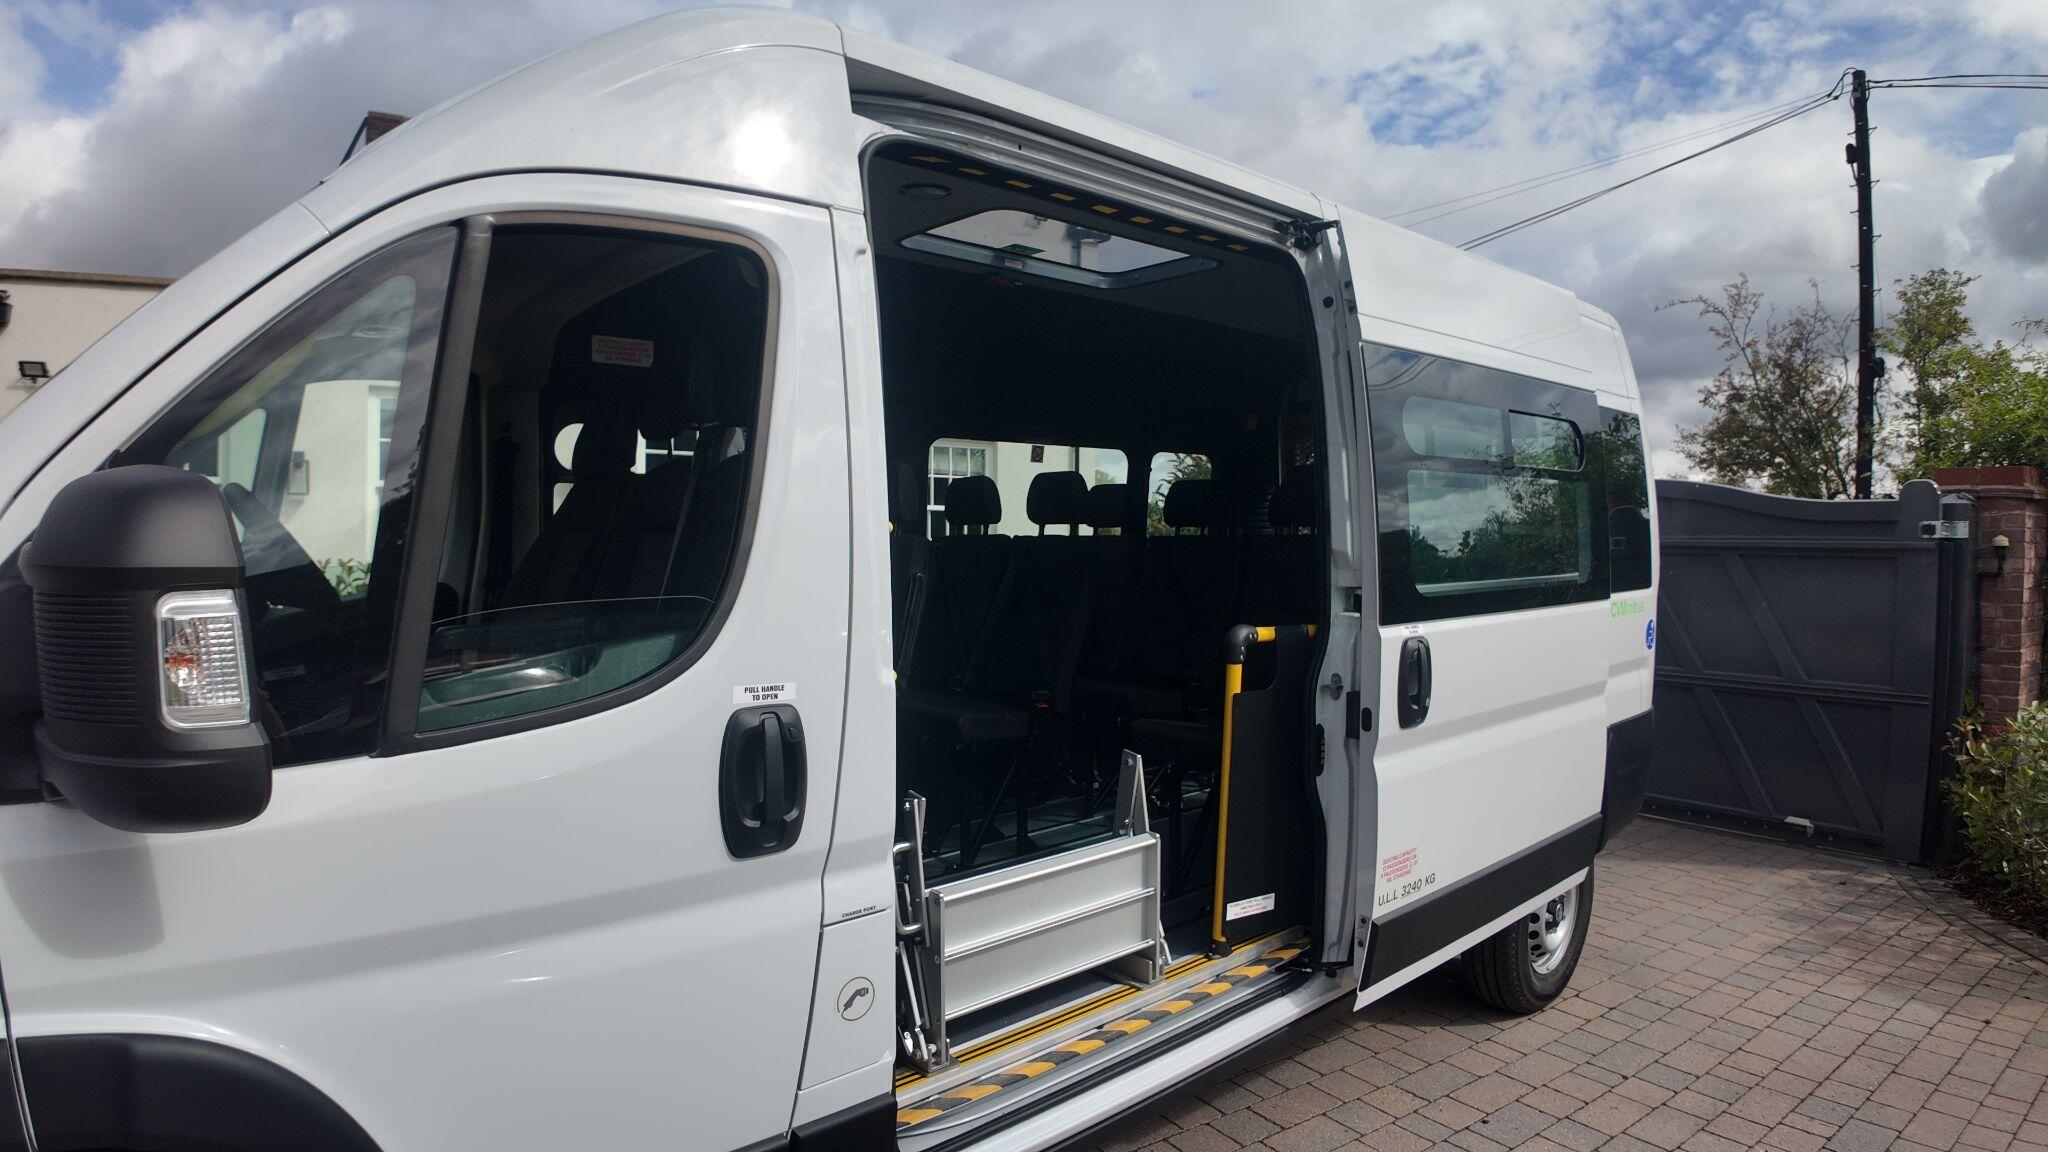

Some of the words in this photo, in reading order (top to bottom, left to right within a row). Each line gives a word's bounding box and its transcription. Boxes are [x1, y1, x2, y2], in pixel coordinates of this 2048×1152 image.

[744, 686, 760, 694] PULL
[761, 684, 785, 693] HANDLE
[761, 693, 779, 701] OPEN
[1401, 878, 1422, 897] 3240
[1425, 872, 1436, 887] KG
